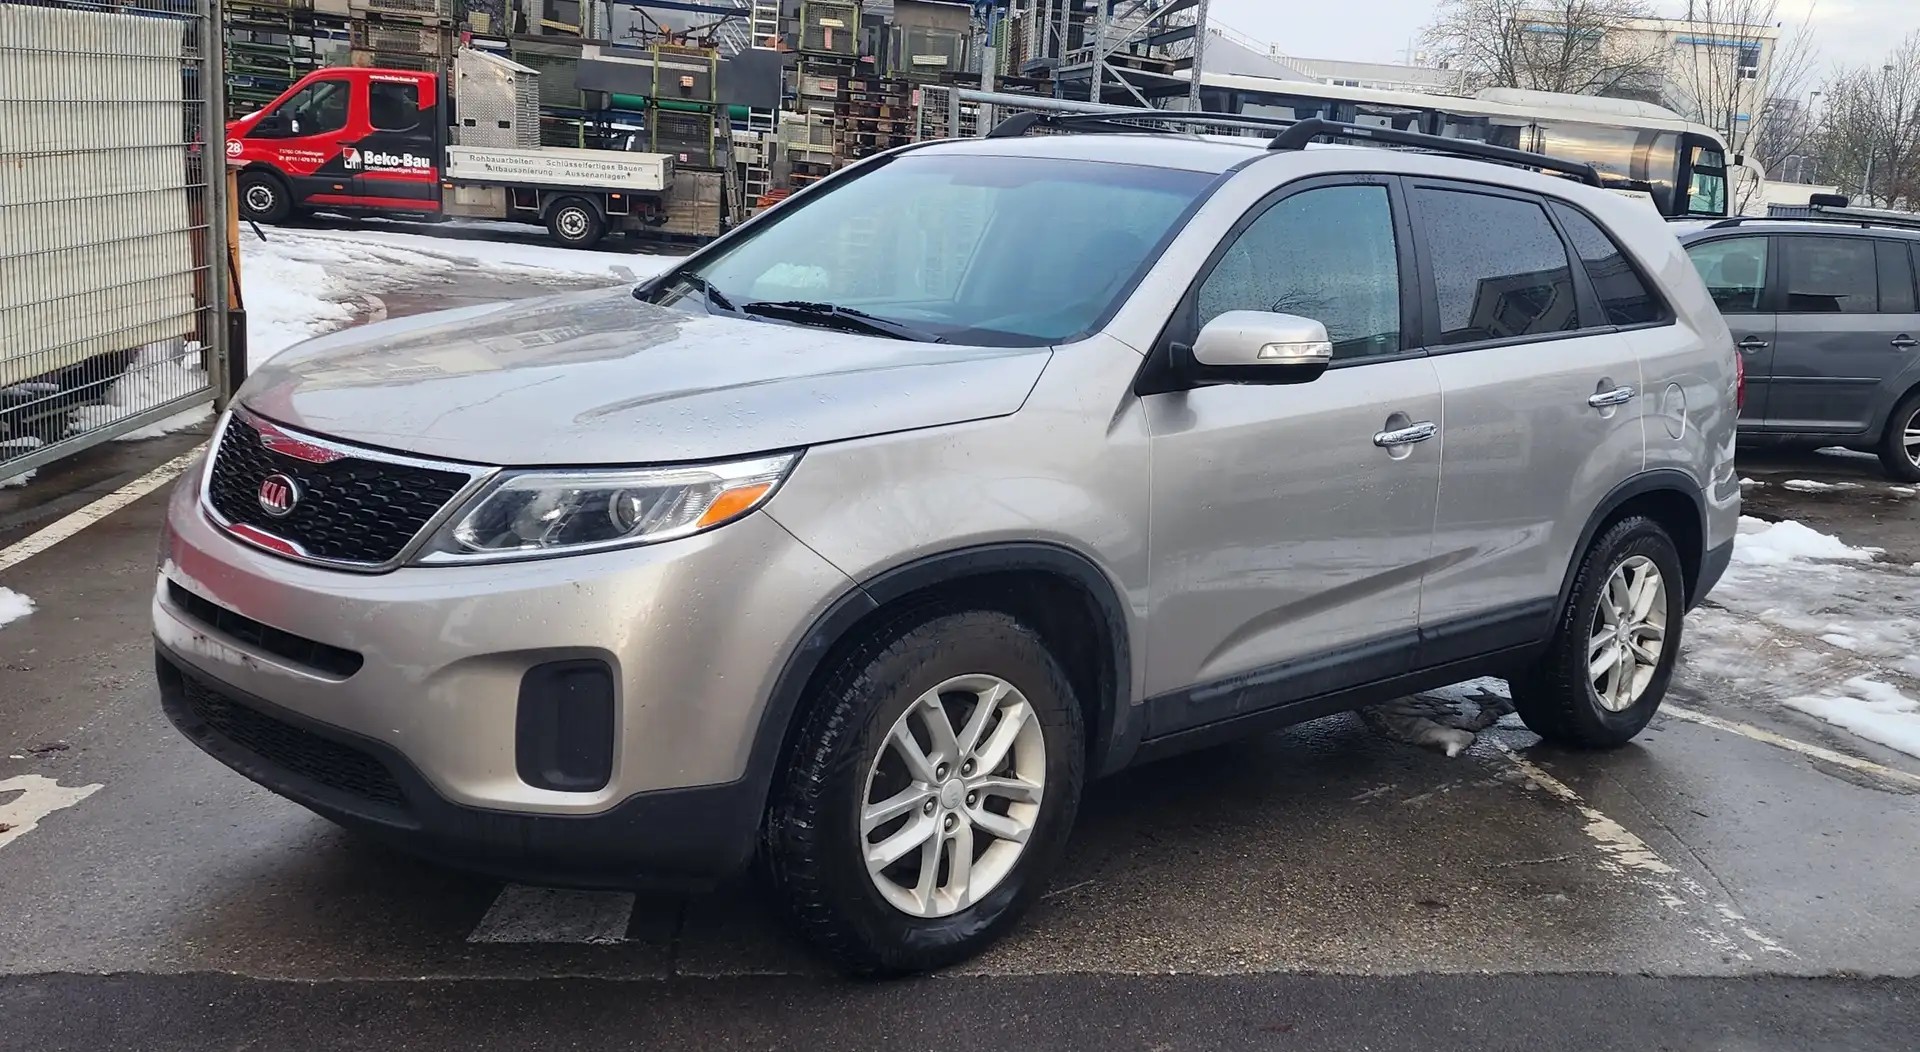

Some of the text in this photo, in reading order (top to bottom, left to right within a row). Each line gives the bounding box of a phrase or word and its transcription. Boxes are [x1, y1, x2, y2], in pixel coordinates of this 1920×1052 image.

[226, 142, 241, 153] 28
[364, 150, 430, 168] Beko-Bau
[469, 154, 534, 165] Rohbauarbeiten
[546, 159, 616, 171] Schlüsselfertiges
[618, 164, 643, 172] Bauen
[364, 164, 412, 174] Schlüsselfertiges
[486, 165, 553, 176] Altbausanierung
[565, 170, 627, 181] Aussenanlagen
[260, 480, 288, 510] KIA
